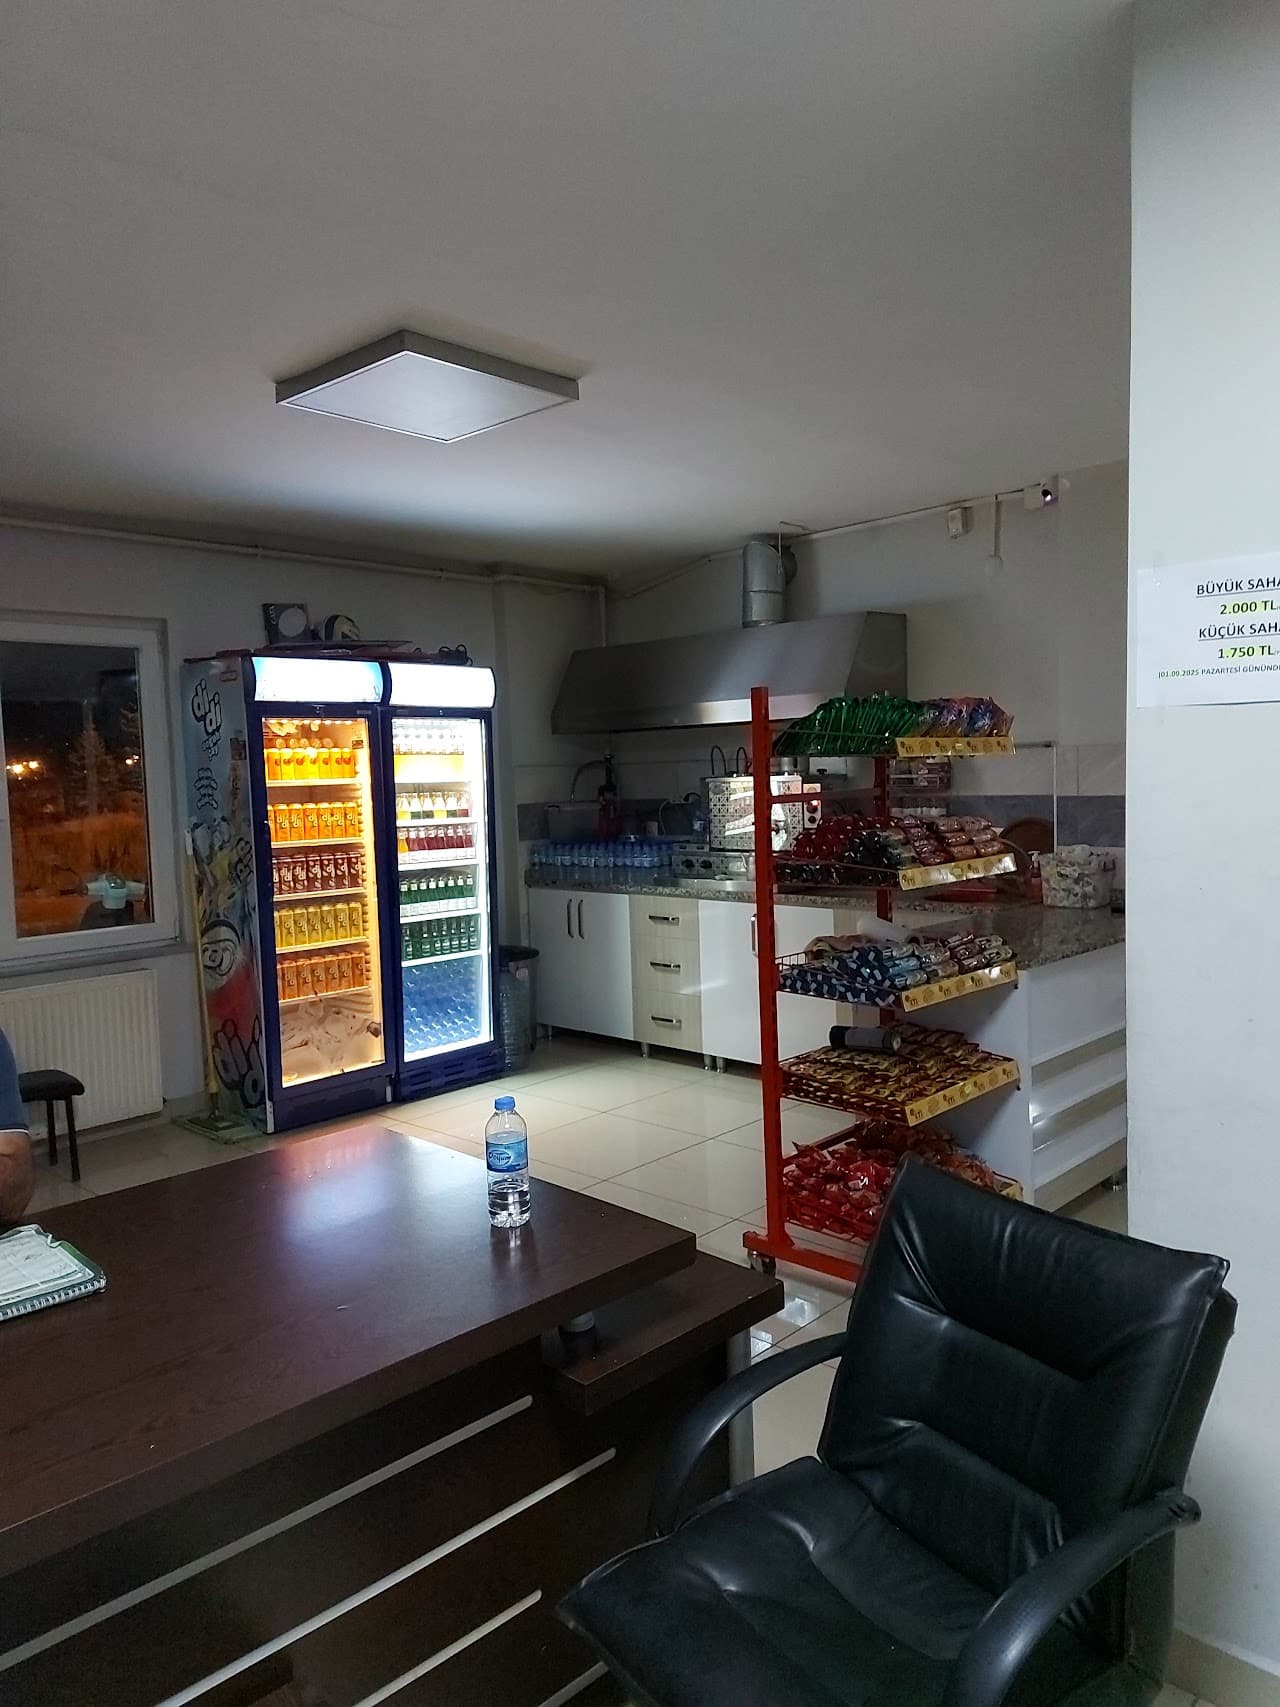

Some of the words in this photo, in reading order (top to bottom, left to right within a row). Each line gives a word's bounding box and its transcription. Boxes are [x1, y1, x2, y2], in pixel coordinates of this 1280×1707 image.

[1197, 578, 1243, 595] BÜYÜK
[1220, 601, 1257, 615] 2.000
[1199, 622, 1245, 639] KÜÇÜK
[1249, 621, 1280, 635] SAH
[1217, 646, 1255, 659] 1.750
[1201, 665, 1241, 676] PAZARTESİ
